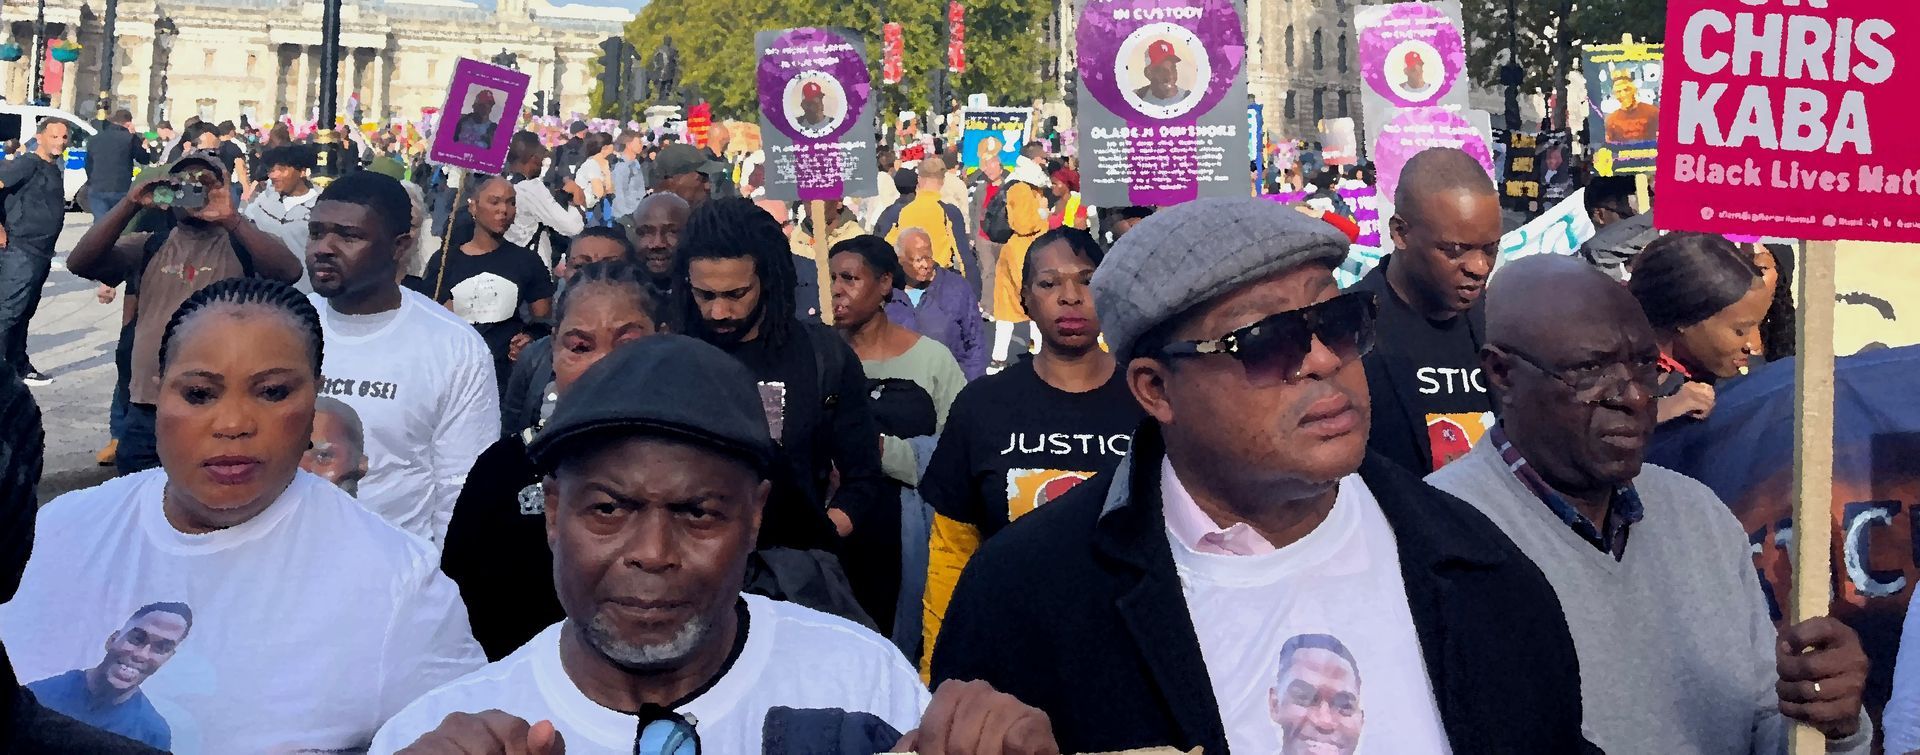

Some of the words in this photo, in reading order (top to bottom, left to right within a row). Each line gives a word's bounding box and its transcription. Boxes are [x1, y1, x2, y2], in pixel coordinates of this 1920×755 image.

[1133, 6, 1204, 20] CUSTODY
[1682, 9, 1896, 85] CHRIS
[1677, 80, 1873, 155] KABA
[1674, 153, 1762, 187] Black
[1770, 160, 1851, 192] Lives
[358, 380, 398, 400] OSEI
[1000, 432, 1131, 456] JUSTIC
